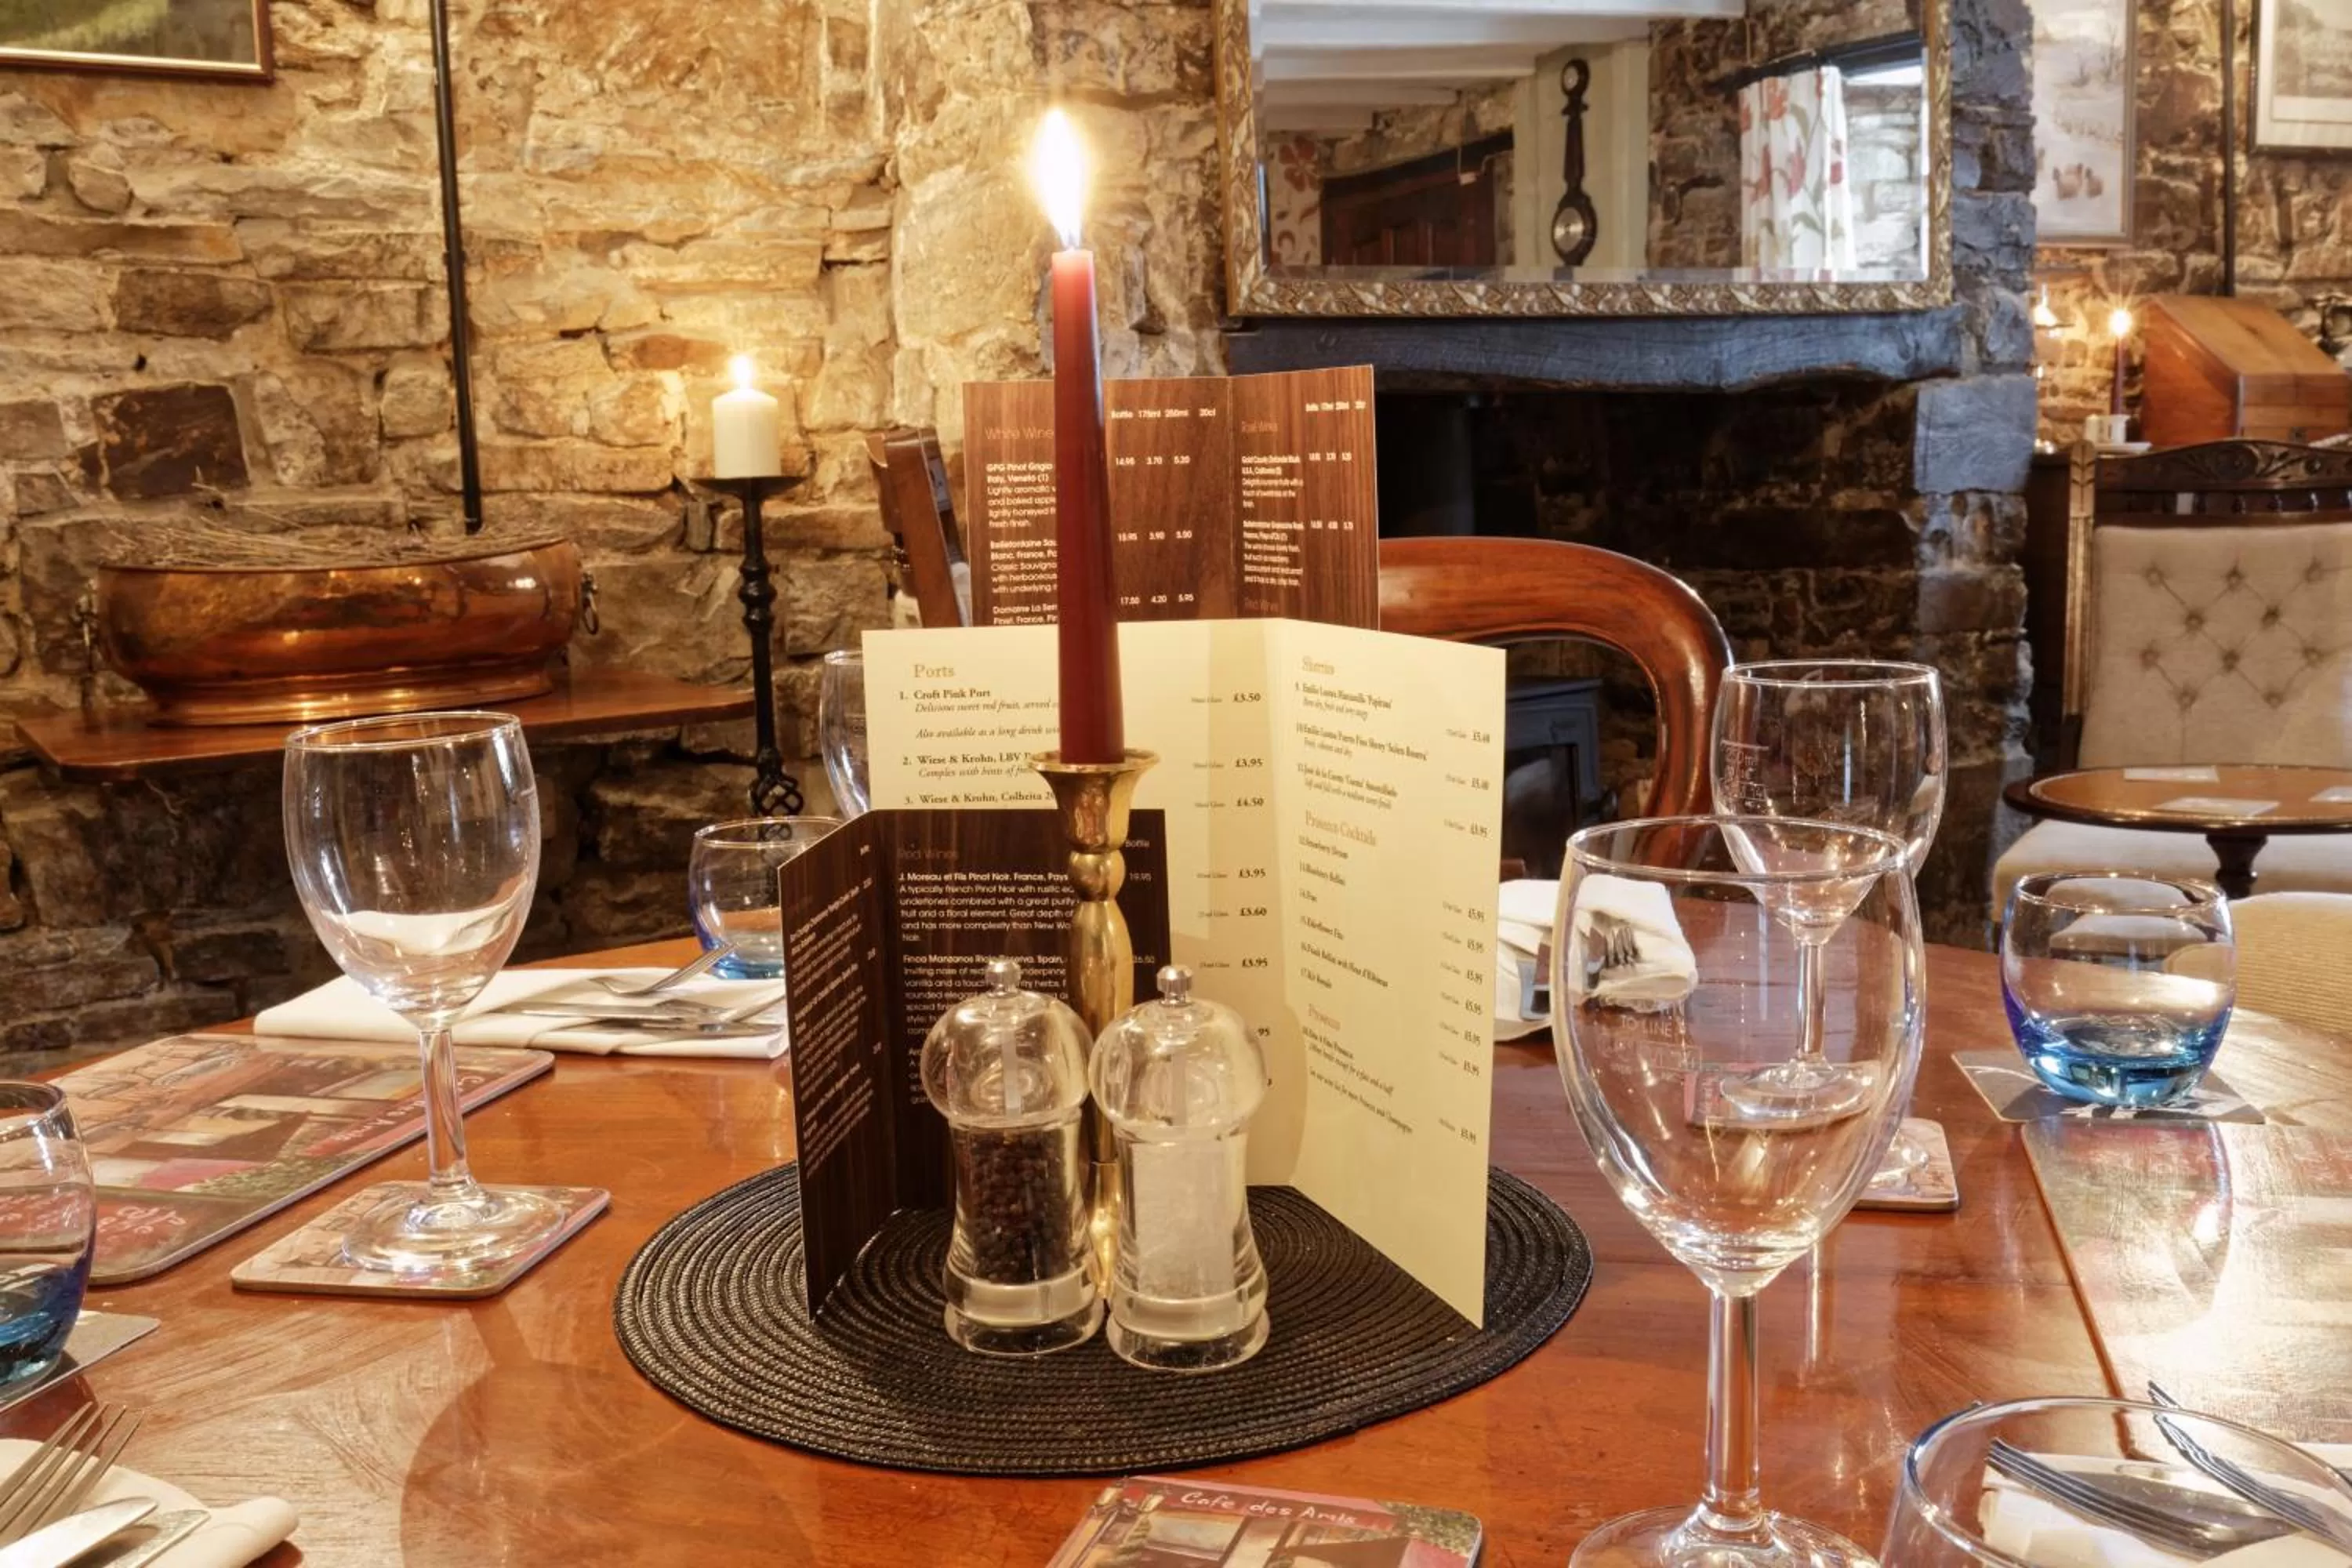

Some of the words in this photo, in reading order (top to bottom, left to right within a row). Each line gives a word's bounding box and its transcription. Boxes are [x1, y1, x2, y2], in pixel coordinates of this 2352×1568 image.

[1022, 426, 1054, 440] Wine
[1020, 561, 1058, 572] Sauvigno
[913, 663, 955, 678] Ports
[899, 690, 909, 700] 1.
[913, 689, 940, 699] Croft
[943, 688, 966, 699] Pink
[969, 688, 990, 698] Port
[998, 726, 1017, 739] long
[902, 756, 912, 765] 2.
[949, 755, 959, 764] &
[962, 753, 996, 764] Krohn,
[999, 752, 1022, 762] LBV
[951, 794, 960, 803] &
[907, 872, 942, 882] Moreau
[968, 872, 989, 881] Pinot
[899, 884, 907, 893] A
[975, 884, 996, 893] Pinot
[1018, 884, 1036, 892] with
[950, 897, 996, 906] combined
[1025, 898, 1050, 907] great
[1009, 909, 1035, 918] Great
[934, 979, 953, 988] and
[963, 979, 986, 988] touc
[1641, 1018, 1673, 1039] LINE
[1181, 1492, 1236, 1509] Cafe
[1250, 1501, 1293, 1516] des
[1300, 1506, 1357, 1525] Amis
